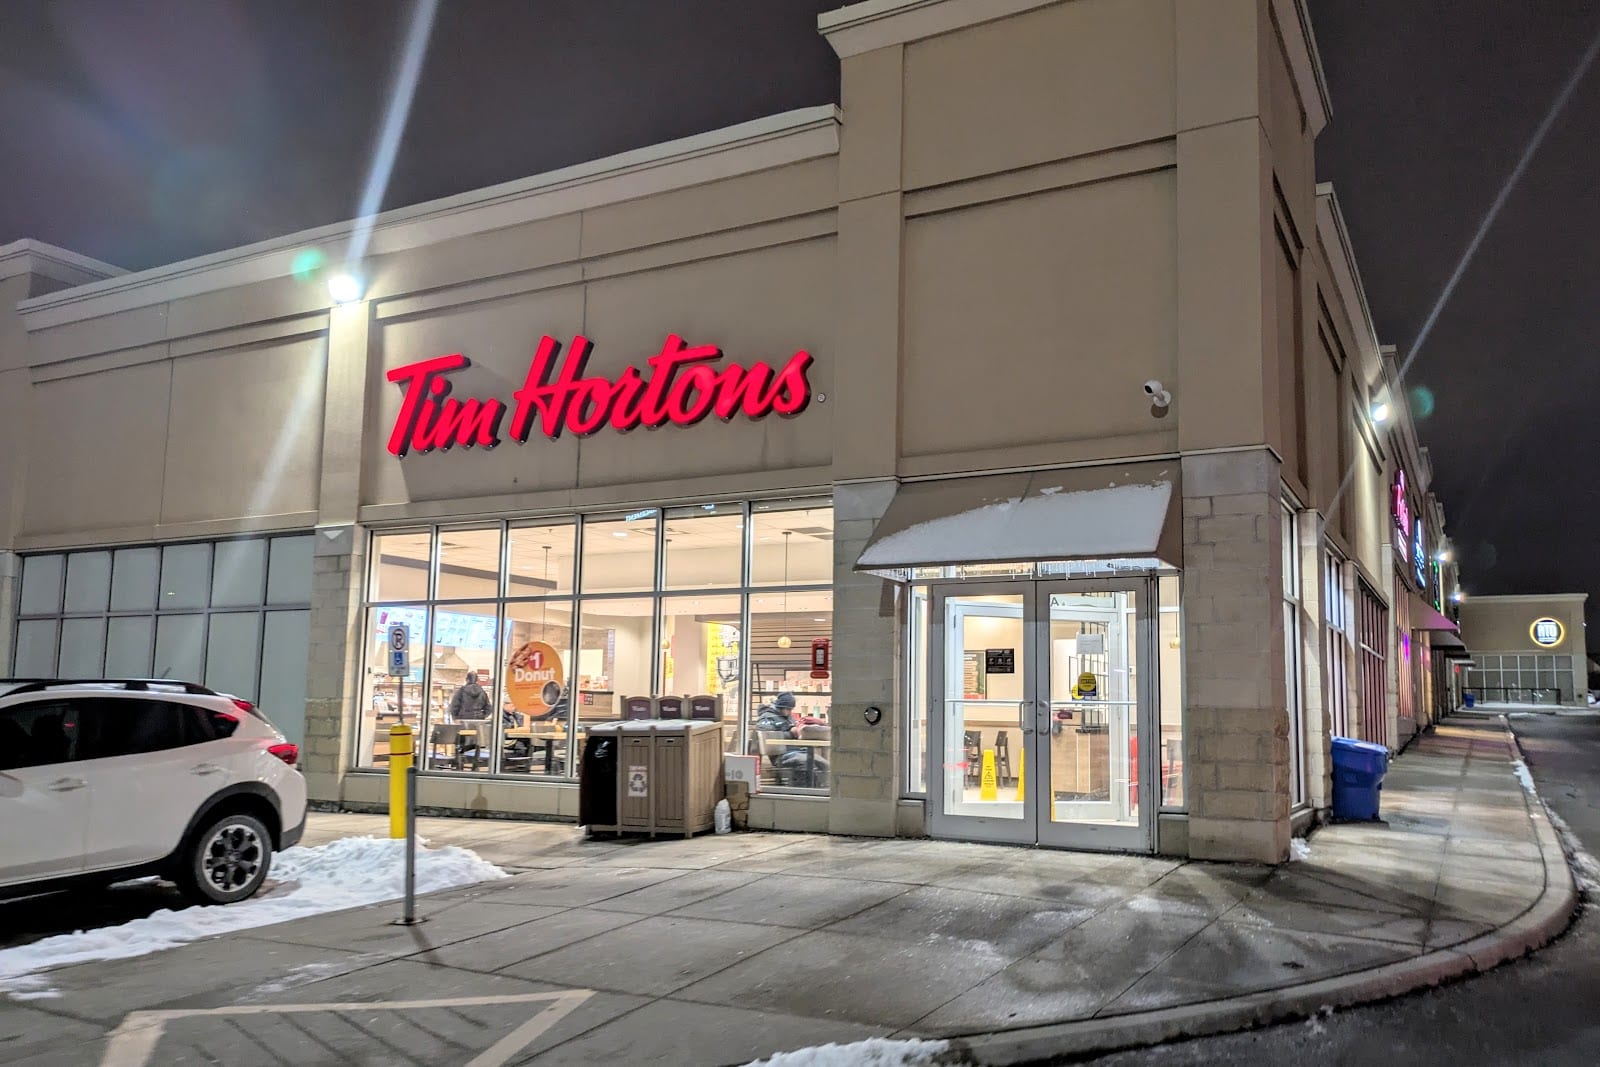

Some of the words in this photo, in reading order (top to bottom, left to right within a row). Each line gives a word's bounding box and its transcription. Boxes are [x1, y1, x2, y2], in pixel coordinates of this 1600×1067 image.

[387, 353, 501, 456] Tim
[509, 333, 814, 443] Hortons
[514, 667, 556, 682] Donut
